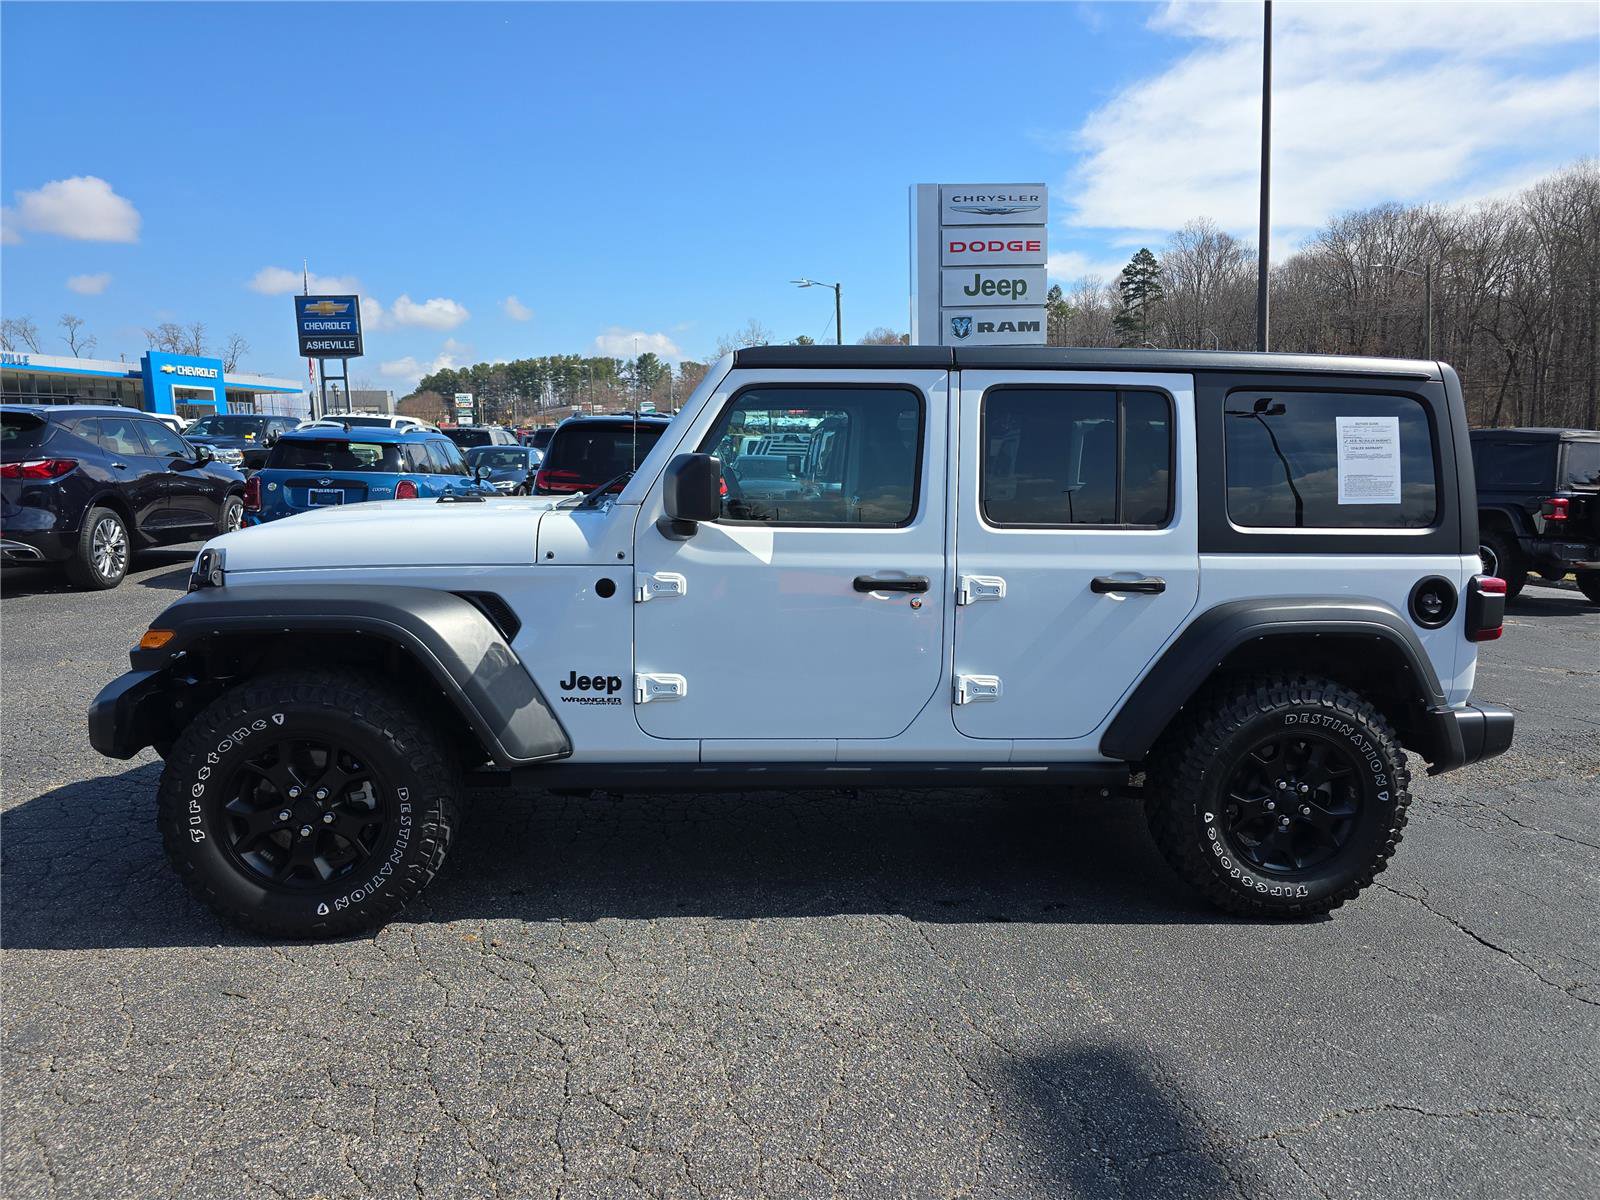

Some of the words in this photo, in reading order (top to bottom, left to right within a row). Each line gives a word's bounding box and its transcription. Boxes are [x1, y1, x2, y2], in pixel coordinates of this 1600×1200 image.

[951, 194, 1039, 203] CHRYSLER
[949, 240, 1041, 253] DODGE
[963, 273, 1028, 300] Jeep
[304, 321, 351, 331] CHEVROLET
[977, 321, 1040, 333] RAM
[306, 340, 355, 350] ASHEVILLE
[177, 365, 218, 378] CHEVROLET
[560, 670, 622, 694] Jeep
[1284, 713, 1388, 787] DESTINATION
[189, 719, 268, 843] Firestone
[334, 787, 411, 911] DESTINATION
[1206, 826, 1308, 898] Firestone
